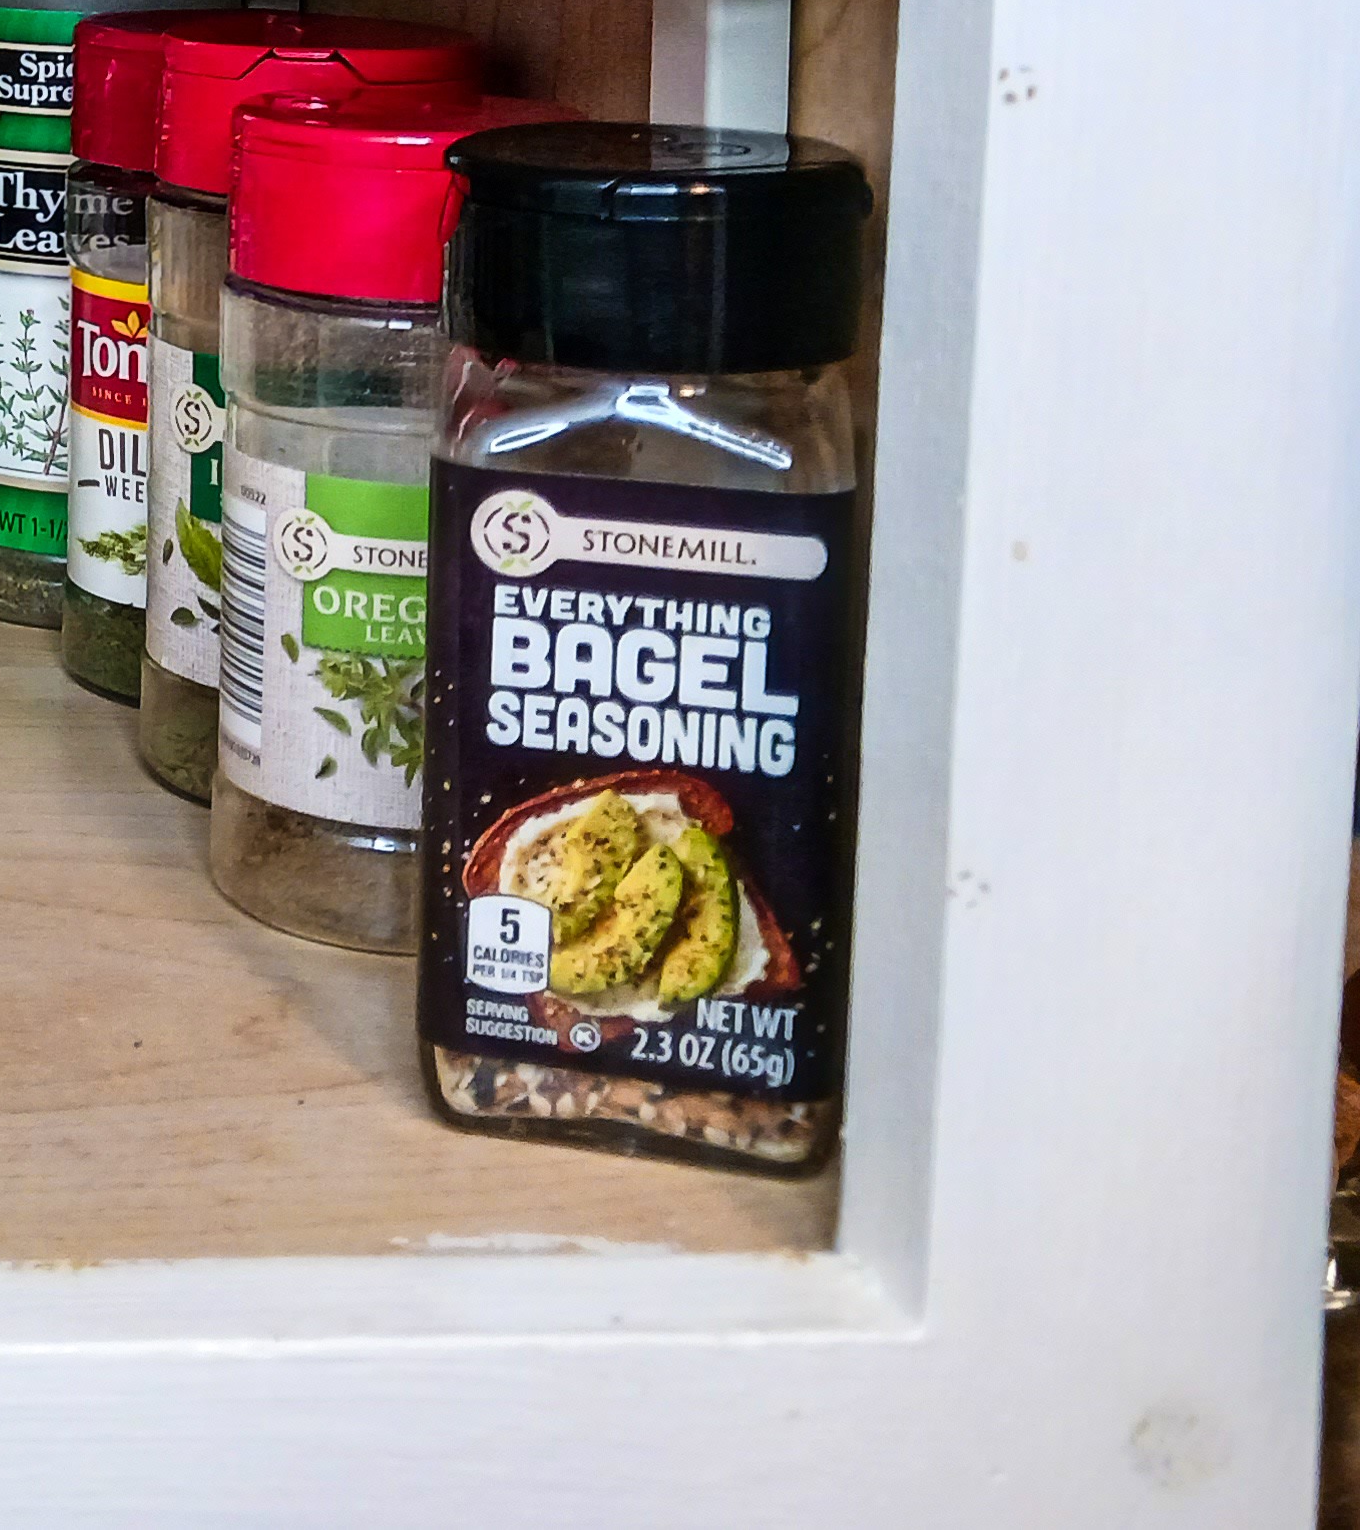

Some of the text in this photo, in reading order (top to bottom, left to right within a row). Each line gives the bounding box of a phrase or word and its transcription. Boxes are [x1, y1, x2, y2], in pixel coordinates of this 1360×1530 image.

[493, 583, 773, 640] EVERYTHING
[489, 616, 800, 718] BAGEL
[485, 690, 798, 778] SEASONING
[499, 908, 520, 945] 5
[473, 945, 545, 969] CALORIES
[465, 1016, 558, 1046] SUGGESTION
[466, 997, 529, 1023] SERVING
[696, 998, 798, 1042] NET WT
[631, 1026, 796, 1088] 2.3 OZ (65g)
